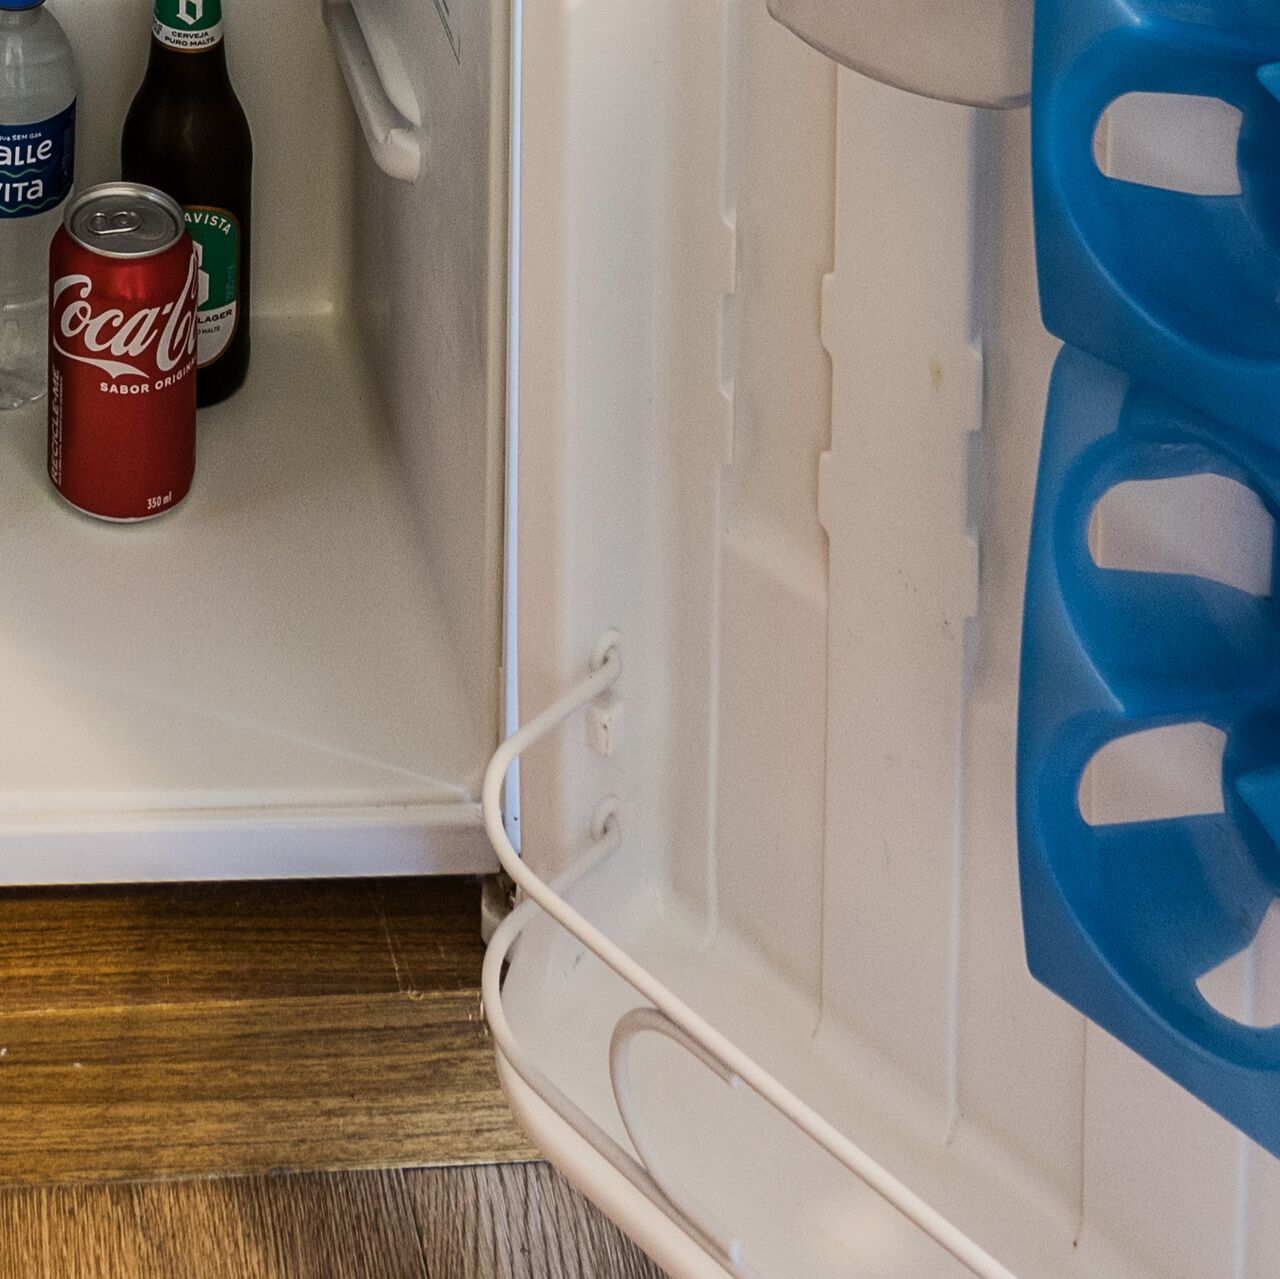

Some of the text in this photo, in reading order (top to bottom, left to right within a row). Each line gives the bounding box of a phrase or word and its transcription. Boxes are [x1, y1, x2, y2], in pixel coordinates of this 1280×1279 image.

[164, 35, 216, 47] PURO MALTE
[171, 30, 209, 40] CERVEJA
[12, 134, 28, 142] SEM
[184, 212, 232, 235] AVISTA
[99, 381, 151, 395] SABOR
[146, 491, 172, 511] 350 ml
